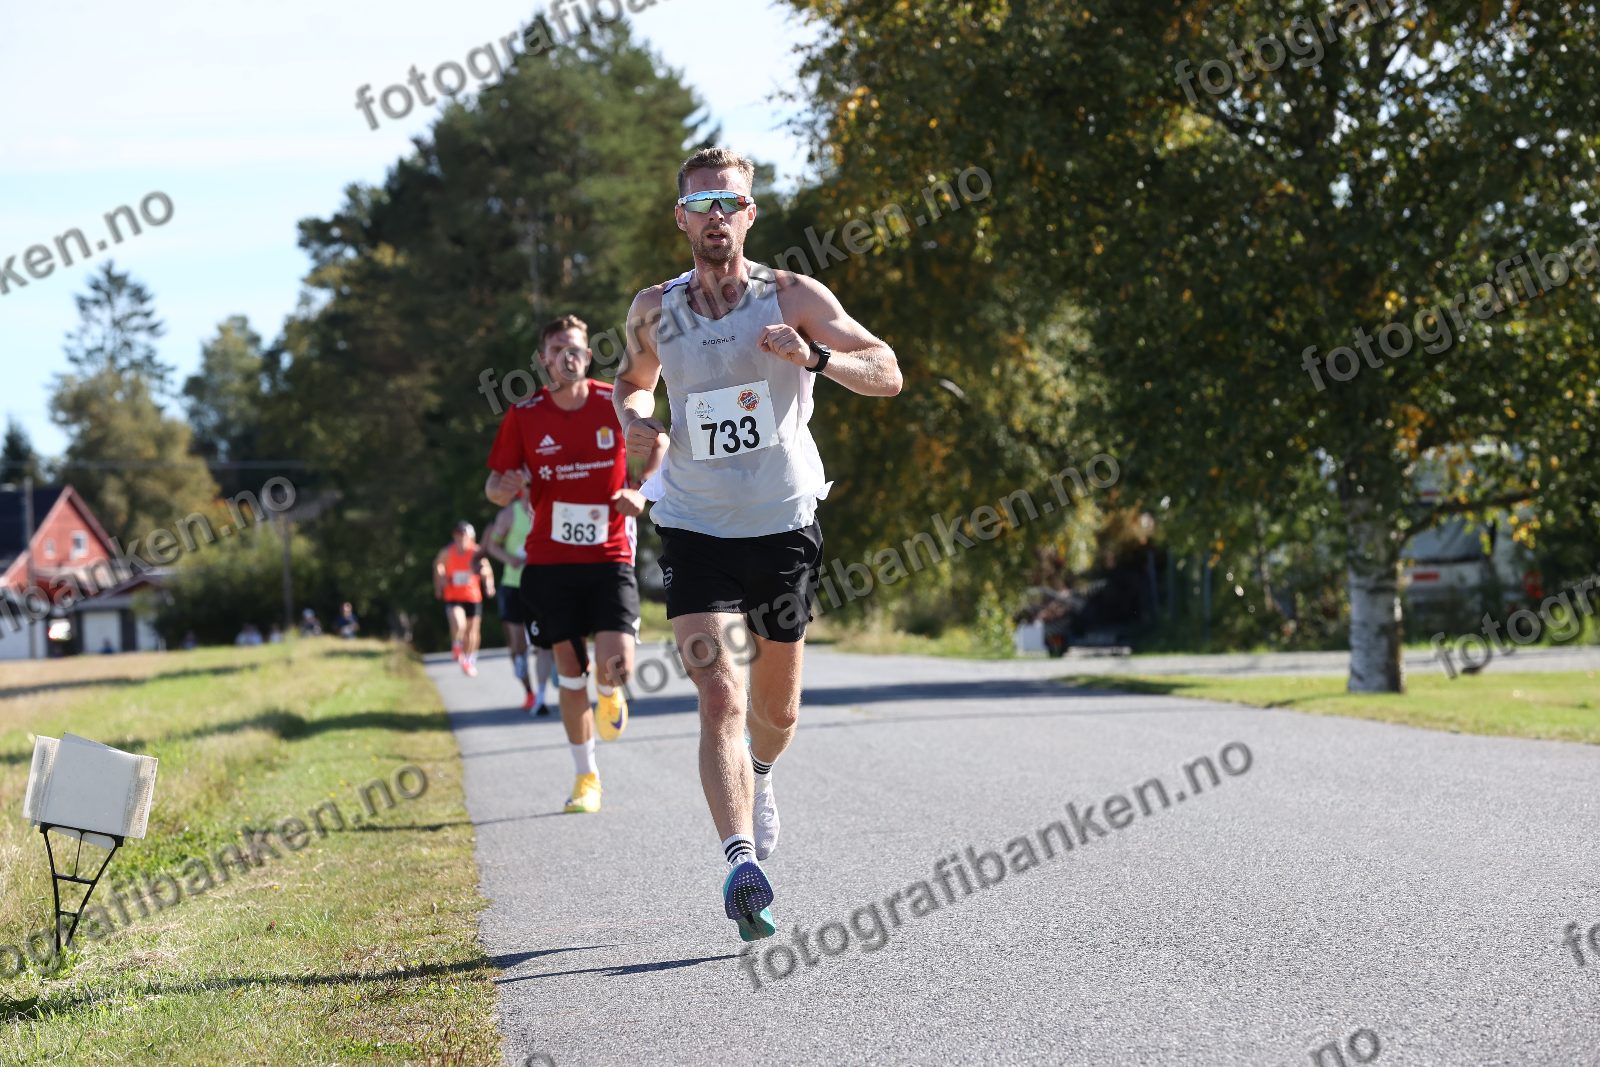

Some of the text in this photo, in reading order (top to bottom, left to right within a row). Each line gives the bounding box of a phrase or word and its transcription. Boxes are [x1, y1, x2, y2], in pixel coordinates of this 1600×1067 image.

[701, 416, 760, 455] 733
[562, 522, 596, 543] 363
[530, 620, 540, 636] 6
